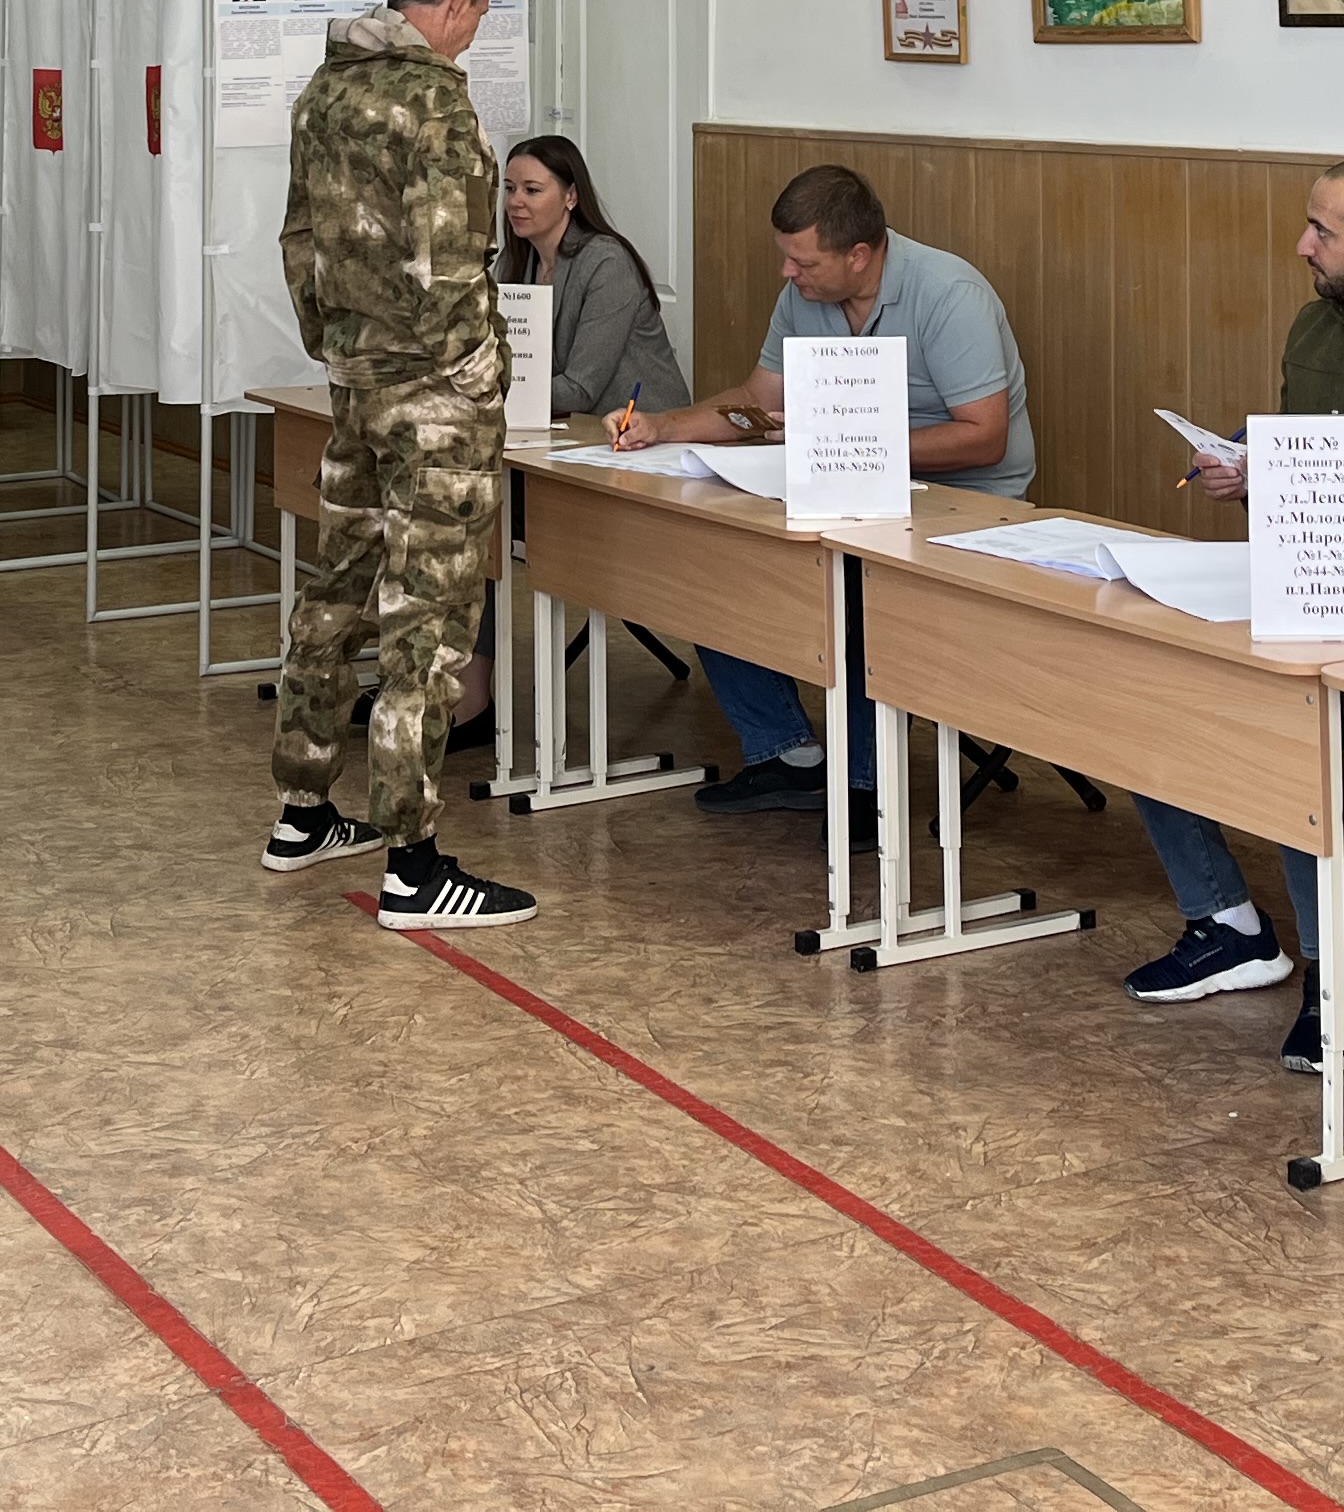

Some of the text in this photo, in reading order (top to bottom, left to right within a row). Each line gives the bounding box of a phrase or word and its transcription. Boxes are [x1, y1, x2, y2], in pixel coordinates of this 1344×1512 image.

[502, 292, 531, 301] №1600
[506, 327, 531, 337] 168)
[811, 346, 879, 357] УИК №1600
[834, 376, 876, 387] Кирова
[832, 405, 880, 416] Красная
[835, 433, 878, 443] Ленина
[1272, 436, 1315, 450] УИК
[1319, 436, 1339, 451] №
